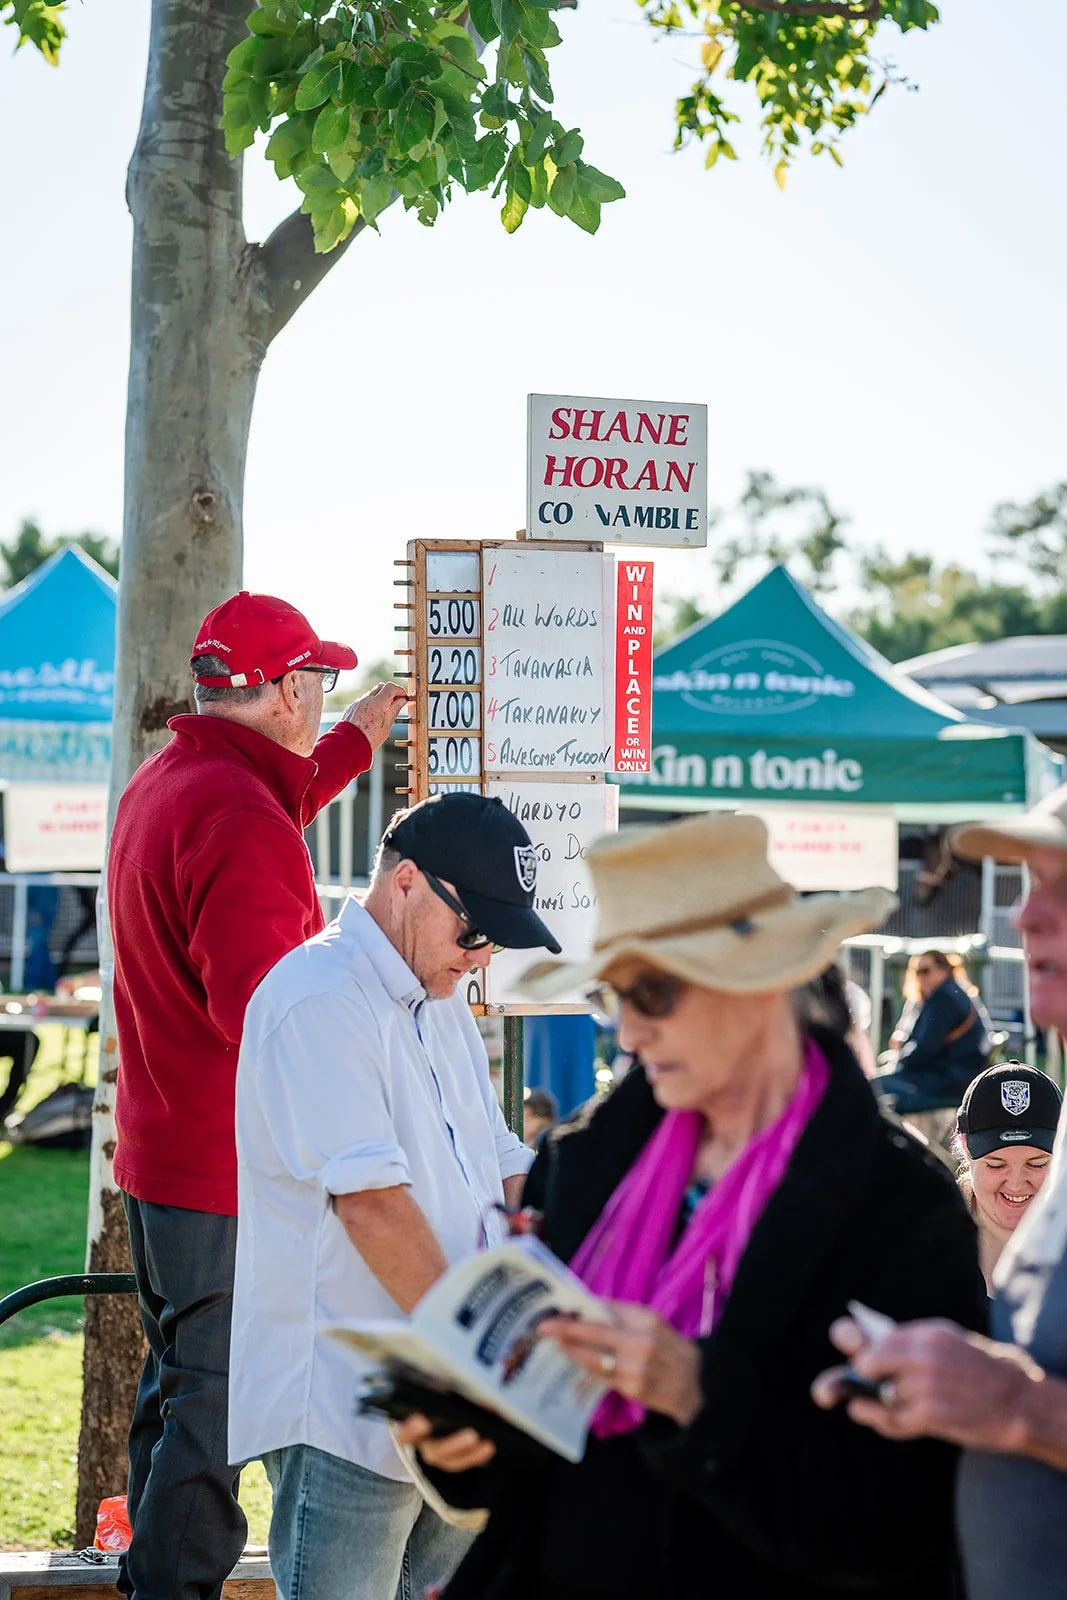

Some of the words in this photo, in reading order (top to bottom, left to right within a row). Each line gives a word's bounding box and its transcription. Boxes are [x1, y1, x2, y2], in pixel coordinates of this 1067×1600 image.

[548, 407, 690, 446] SHANE
[543, 454, 695, 493] HORAN
[625, 566, 646, 621] WIN
[429, 600, 475, 635] 5.00
[488, 607, 499, 631] 2
[623, 626, 646, 636] AND
[431, 649, 477, 685] 2.20
[488, 655, 498, 676] 3
[625, 639, 642, 735] PLACE
[428, 691, 475, 728] 7.00
[428, 737, 473, 774] 5.00
[620, 749, 646, 759] WIN
[625, 737, 641, 747] OR
[617, 761, 649, 772] ONLY
[711, 752, 744, 789] n
[749, 748, 864, 792] tonic
